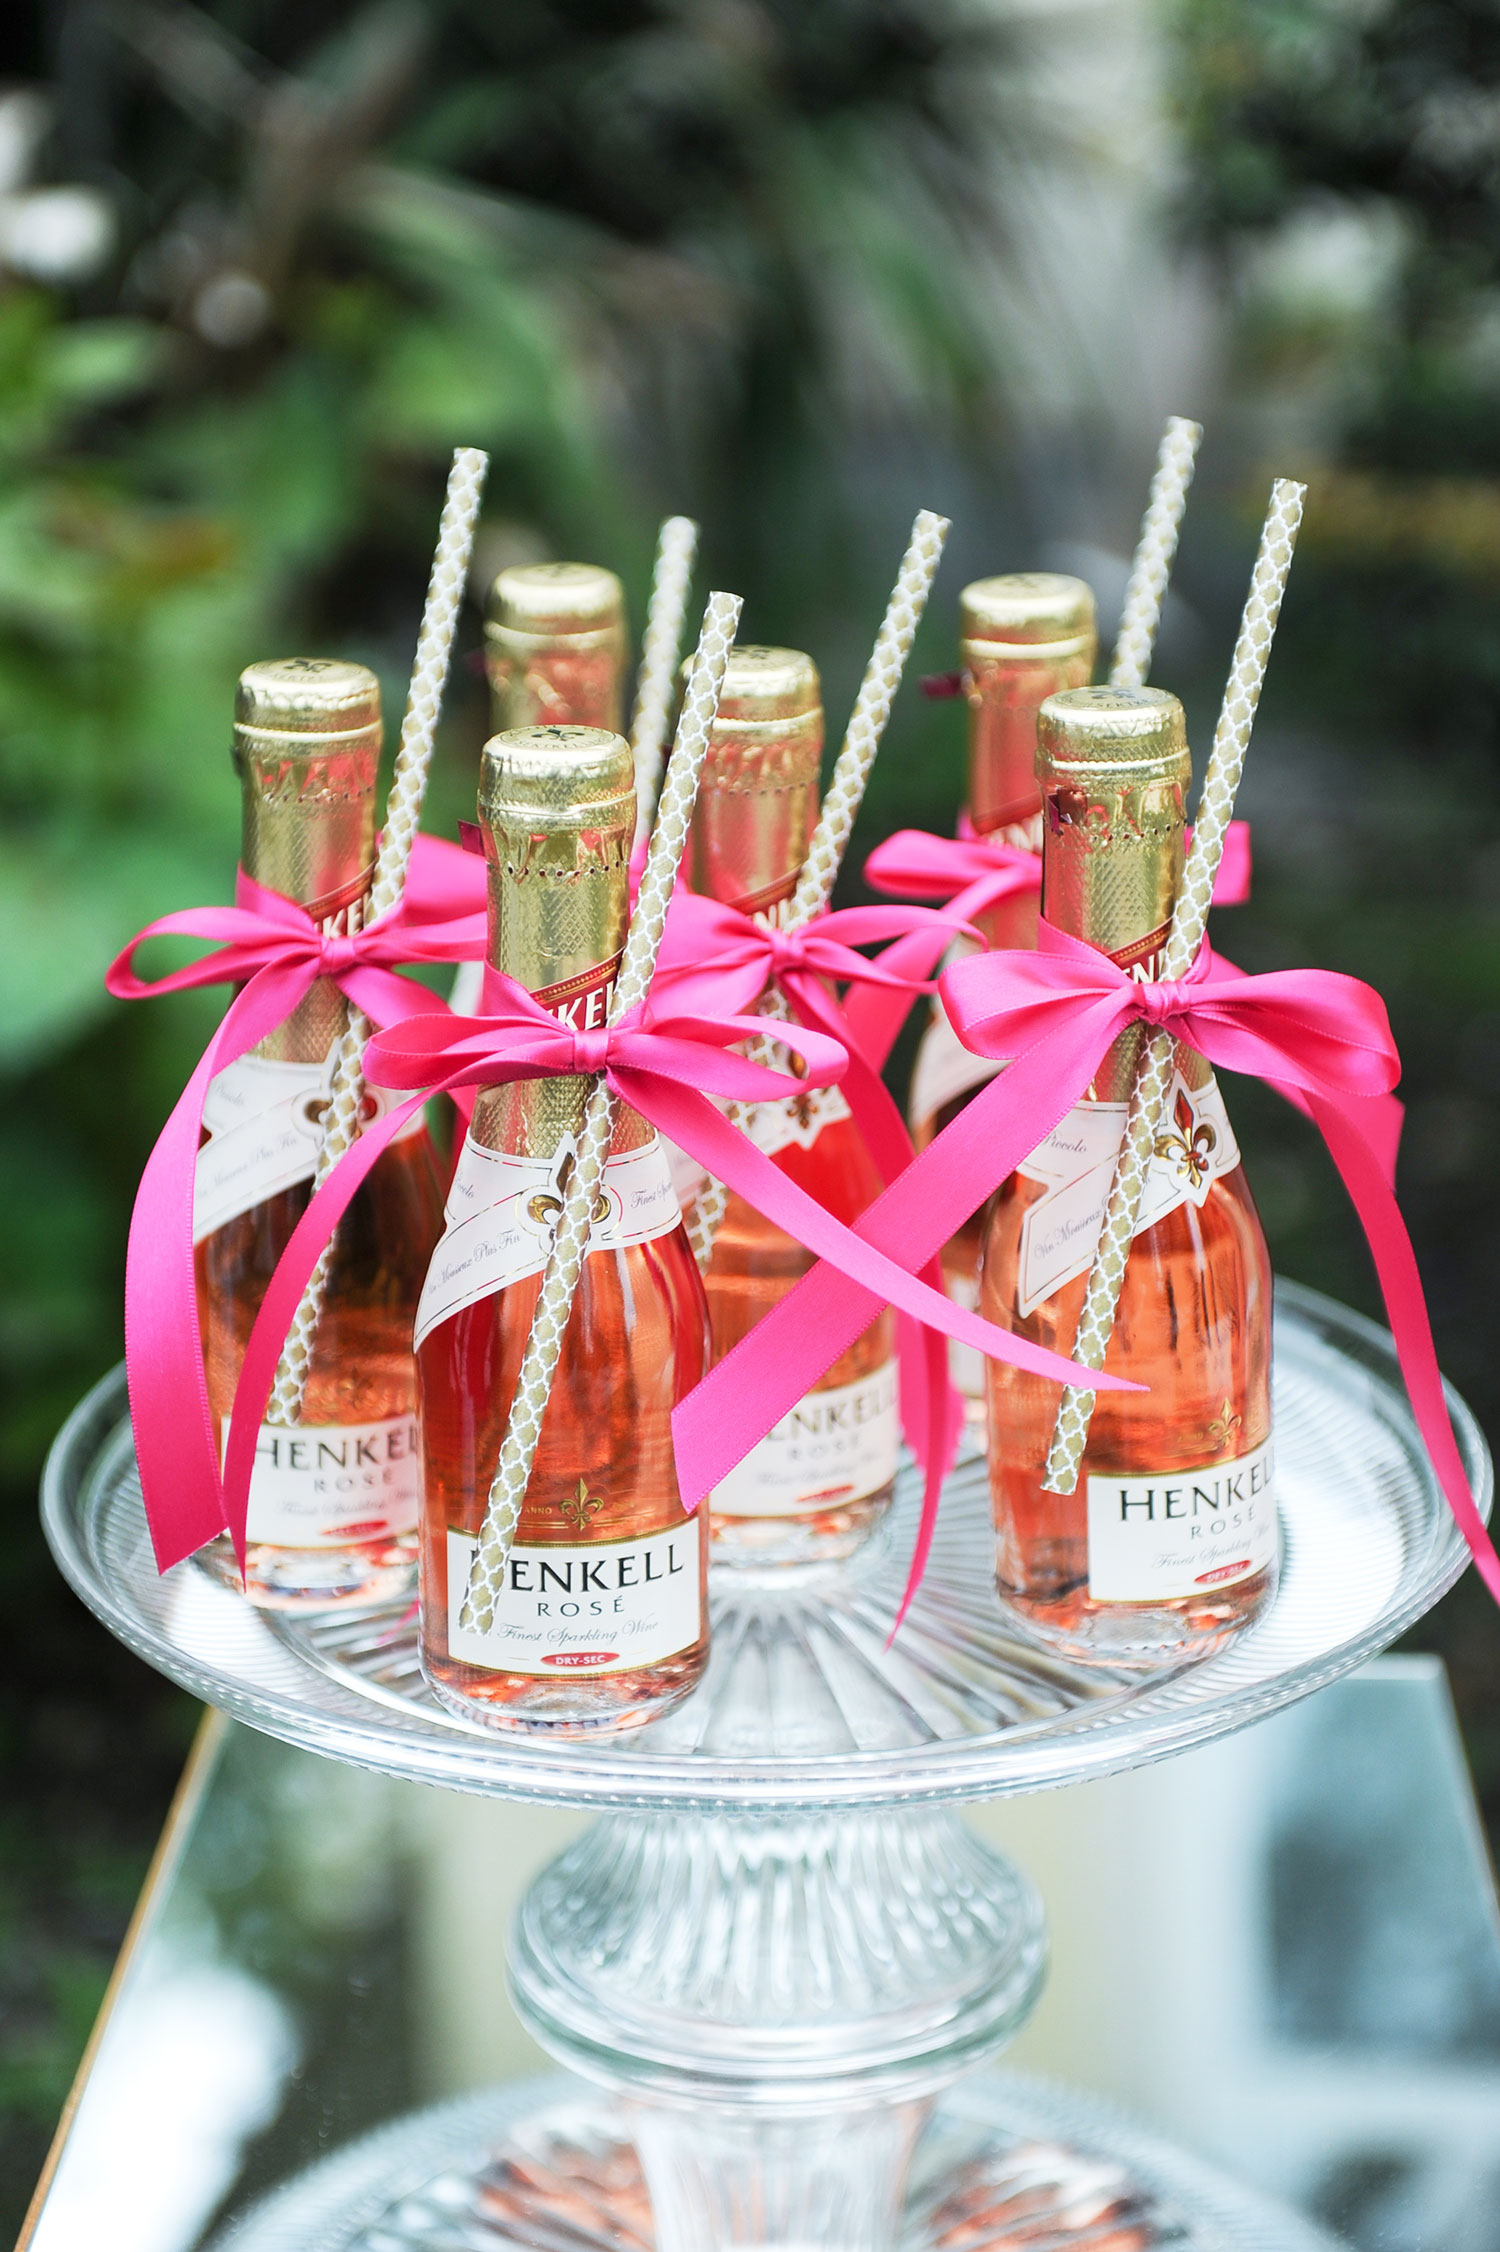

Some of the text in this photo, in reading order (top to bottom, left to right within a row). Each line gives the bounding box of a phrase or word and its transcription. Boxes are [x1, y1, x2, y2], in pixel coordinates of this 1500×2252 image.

[471, 1544, 685, 1593] ENKELL
[536, 1595, 625, 1618] ROSÉ
[497, 1612, 660, 1648] Finest Sparkling Wine
[555, 1654, 606, 1666] DRY-SEC
